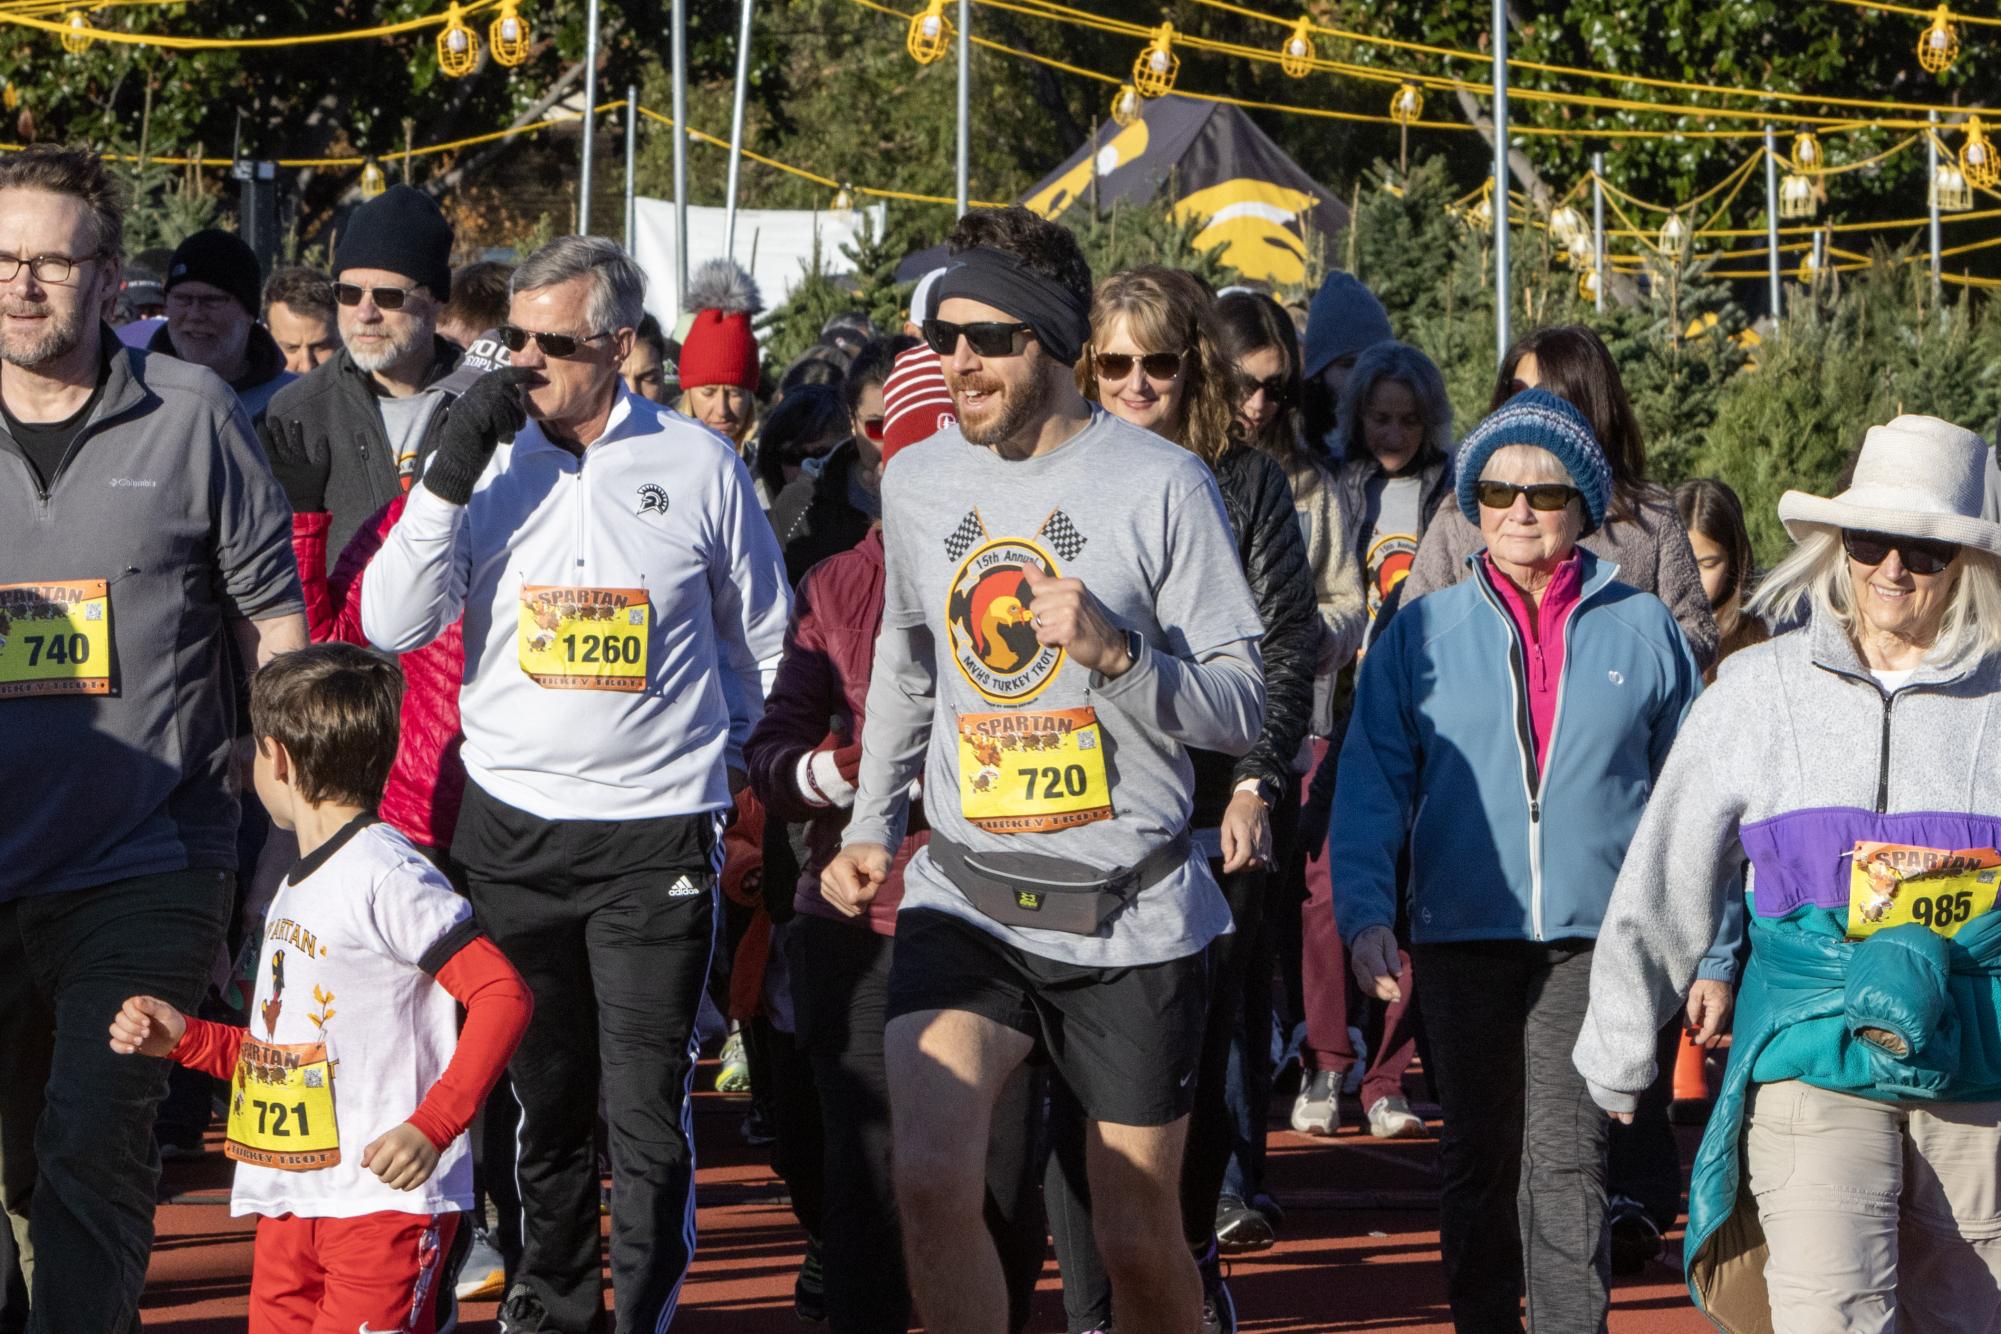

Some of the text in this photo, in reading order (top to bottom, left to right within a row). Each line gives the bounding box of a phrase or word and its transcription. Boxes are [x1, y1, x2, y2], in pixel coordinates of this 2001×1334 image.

[976, 552, 1000, 569] 15th
[538, 590, 628, 610] SPARTAN
[24, 633, 90, 667] 740
[562, 634, 641, 664] 1260
[963, 649, 1055, 692] MVHS TURKEY TROT
[975, 715, 1074, 736] SPARTAN
[1018, 763, 1088, 801] 720
[1875, 851, 1983, 871] SPARTAN
[668, 887, 700, 897] adidas
[1912, 891, 1974, 928] 985
[253, 1099, 310, 1137] 721
